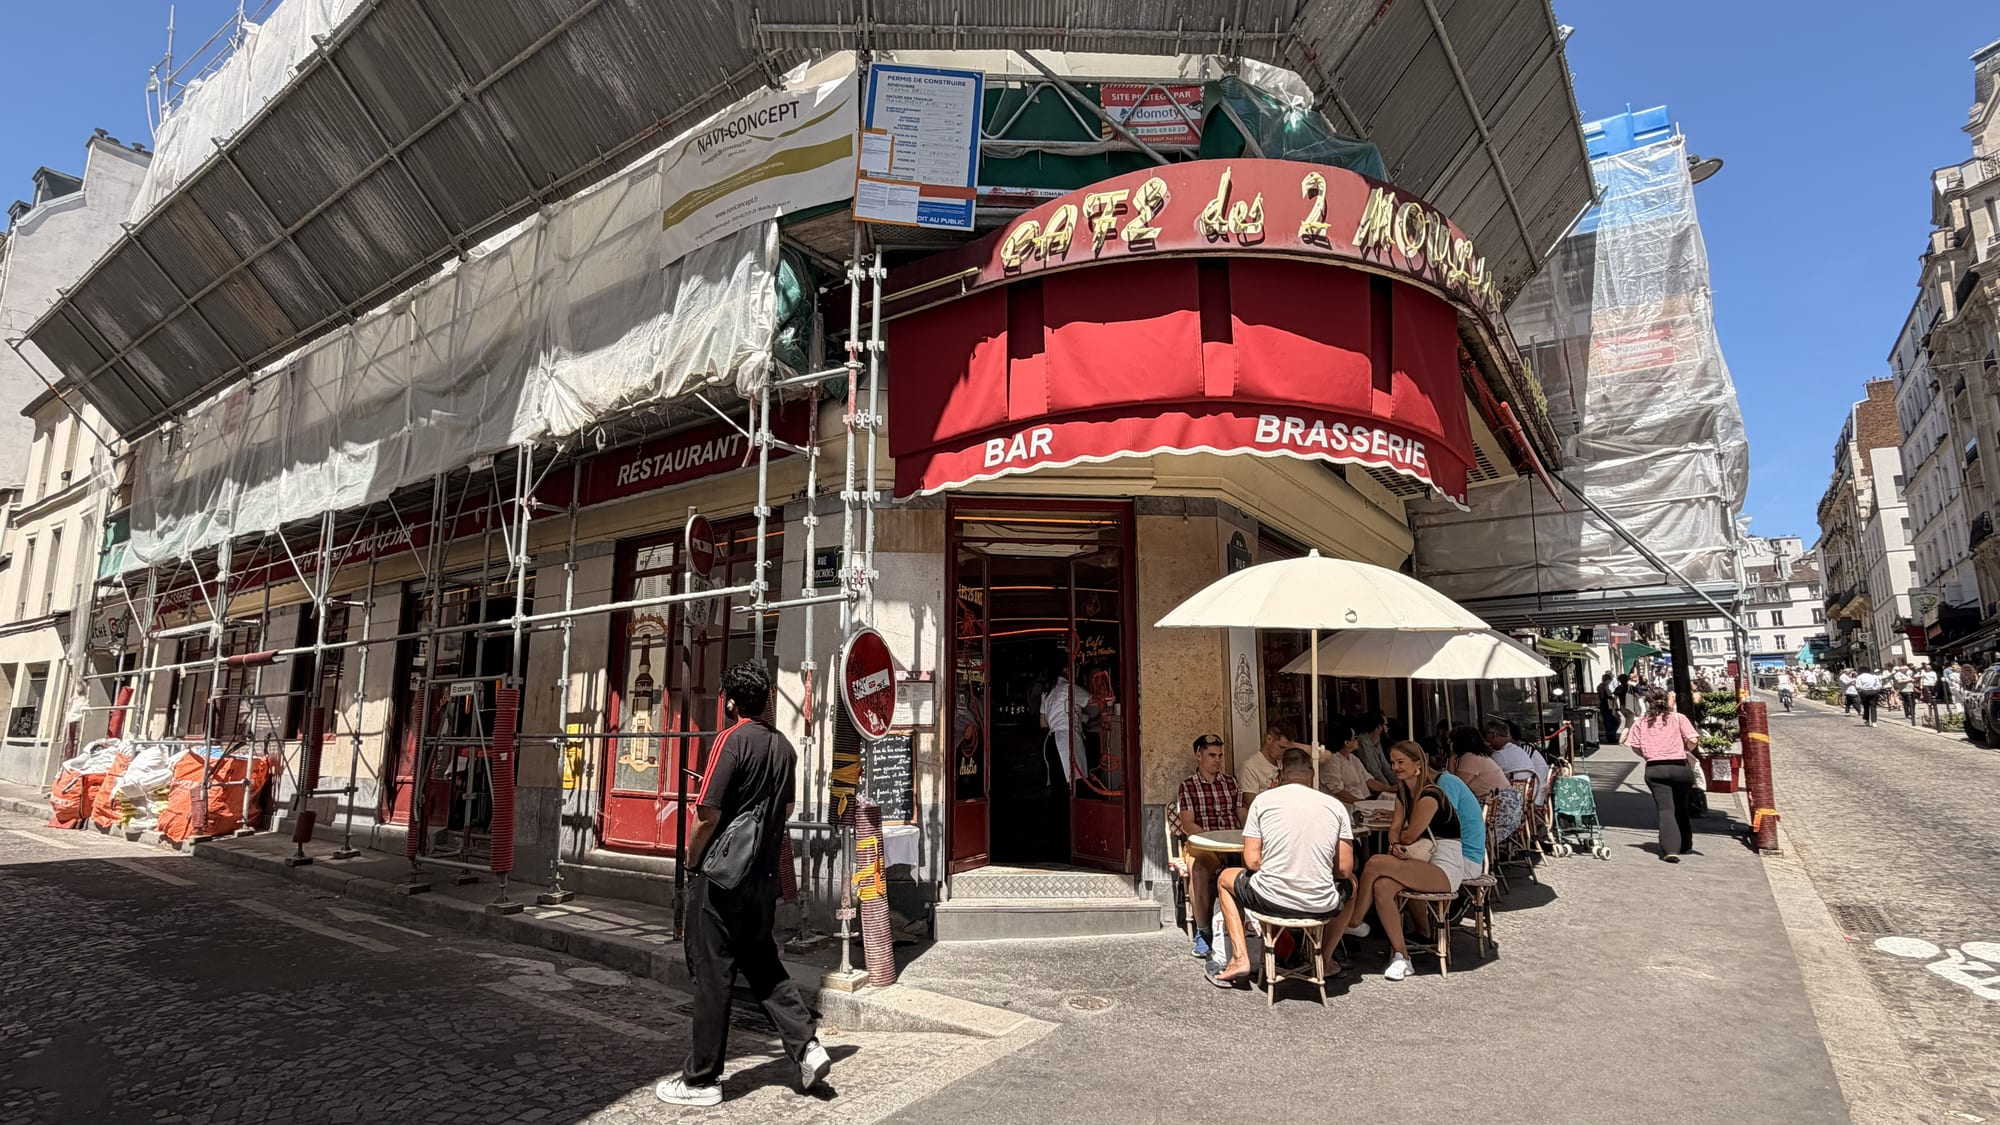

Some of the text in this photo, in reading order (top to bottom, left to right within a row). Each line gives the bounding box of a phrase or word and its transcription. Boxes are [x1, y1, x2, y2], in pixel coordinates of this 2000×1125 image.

[887, 75, 912, 83] PERMIS
[923, 78, 966, 87] CONSTRUIRE
[1111, 93, 1130, 101] SITE
[1136, 108, 1182, 120] domoty
[697, 100, 800, 156] NAVI-CONCEPT
[1200, 166, 1264, 236] des
[1298, 171, 1331, 237] 2
[940, 216, 965, 225] PUBLIC
[983, 427, 1053, 468] BAR
[1255, 415, 1427, 470] BRASSERIE
[617, 432, 743, 486] RESTAURANT
[815, 568, 835, 578] UCHOIS
